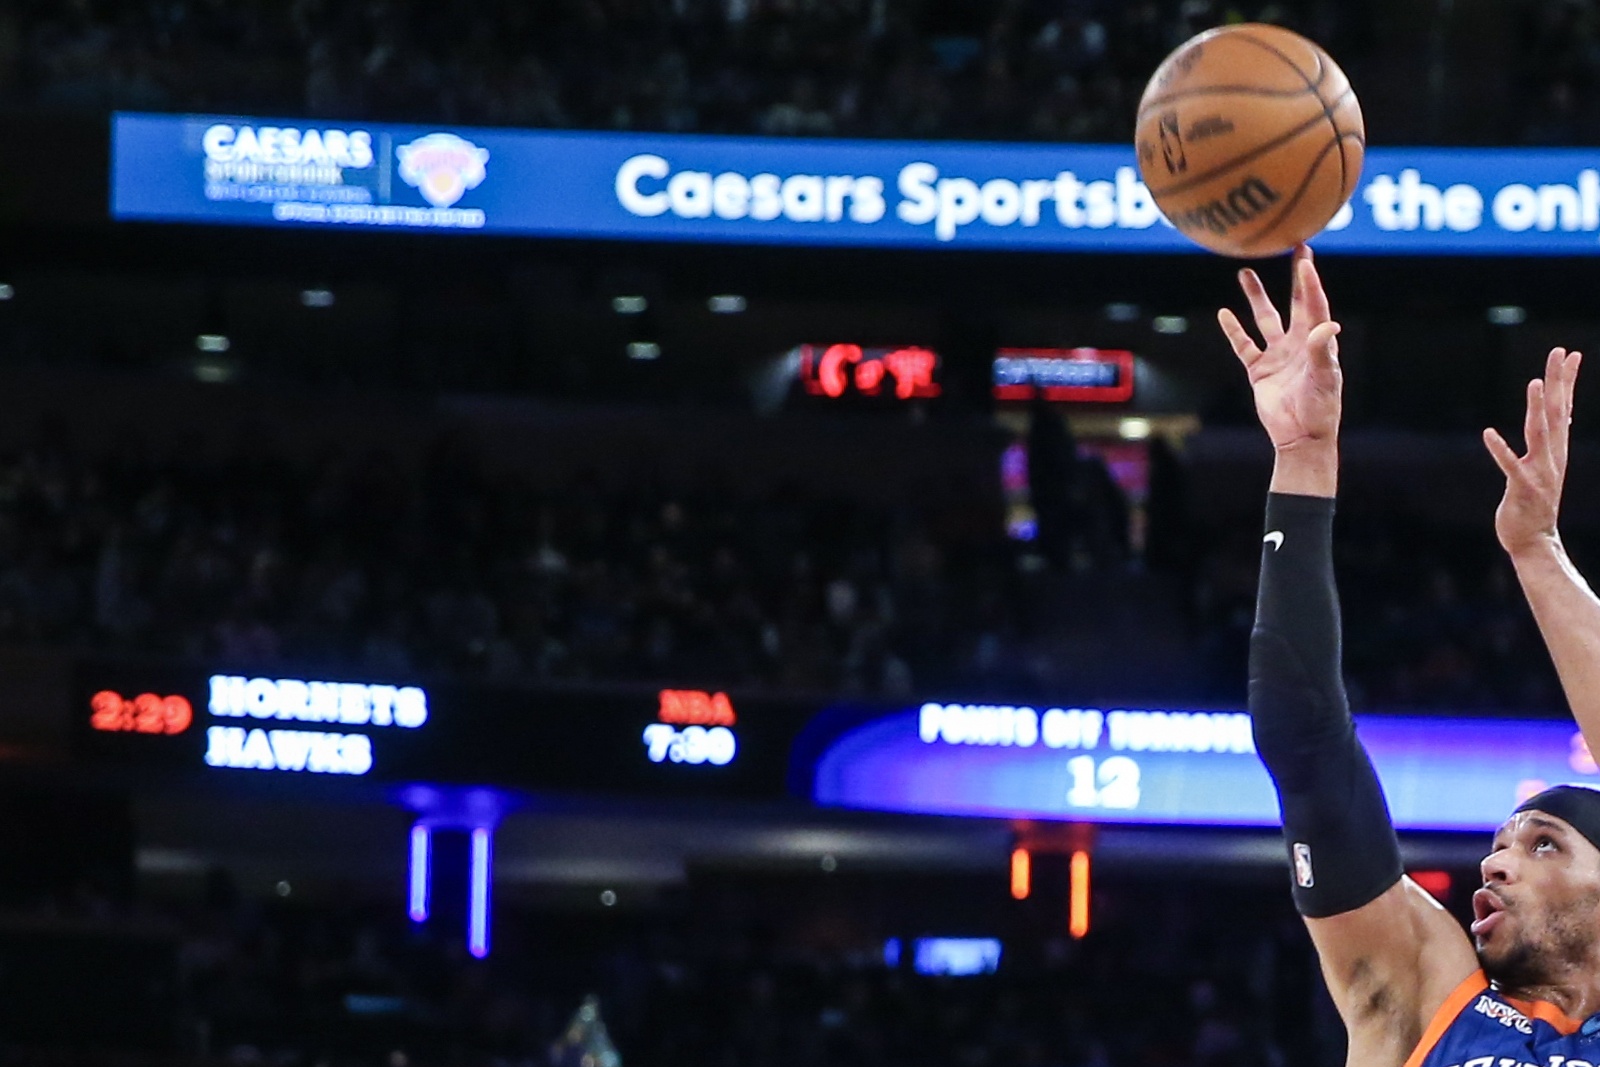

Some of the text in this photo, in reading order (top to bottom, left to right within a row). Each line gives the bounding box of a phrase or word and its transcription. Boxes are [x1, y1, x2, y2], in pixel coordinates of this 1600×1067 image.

[203, 125, 373, 169] CAESARS
[616, 154, 885, 222] Caesars
[899, 162, 1173, 241] Sportsb
[1365, 169, 1483, 230] the
[209, 675, 427, 728] HORNETS
[207, 726, 372, 774] HAWKS
[1066, 756, 1140, 809] 12
[1474, 995, 1533, 1034] NYC
